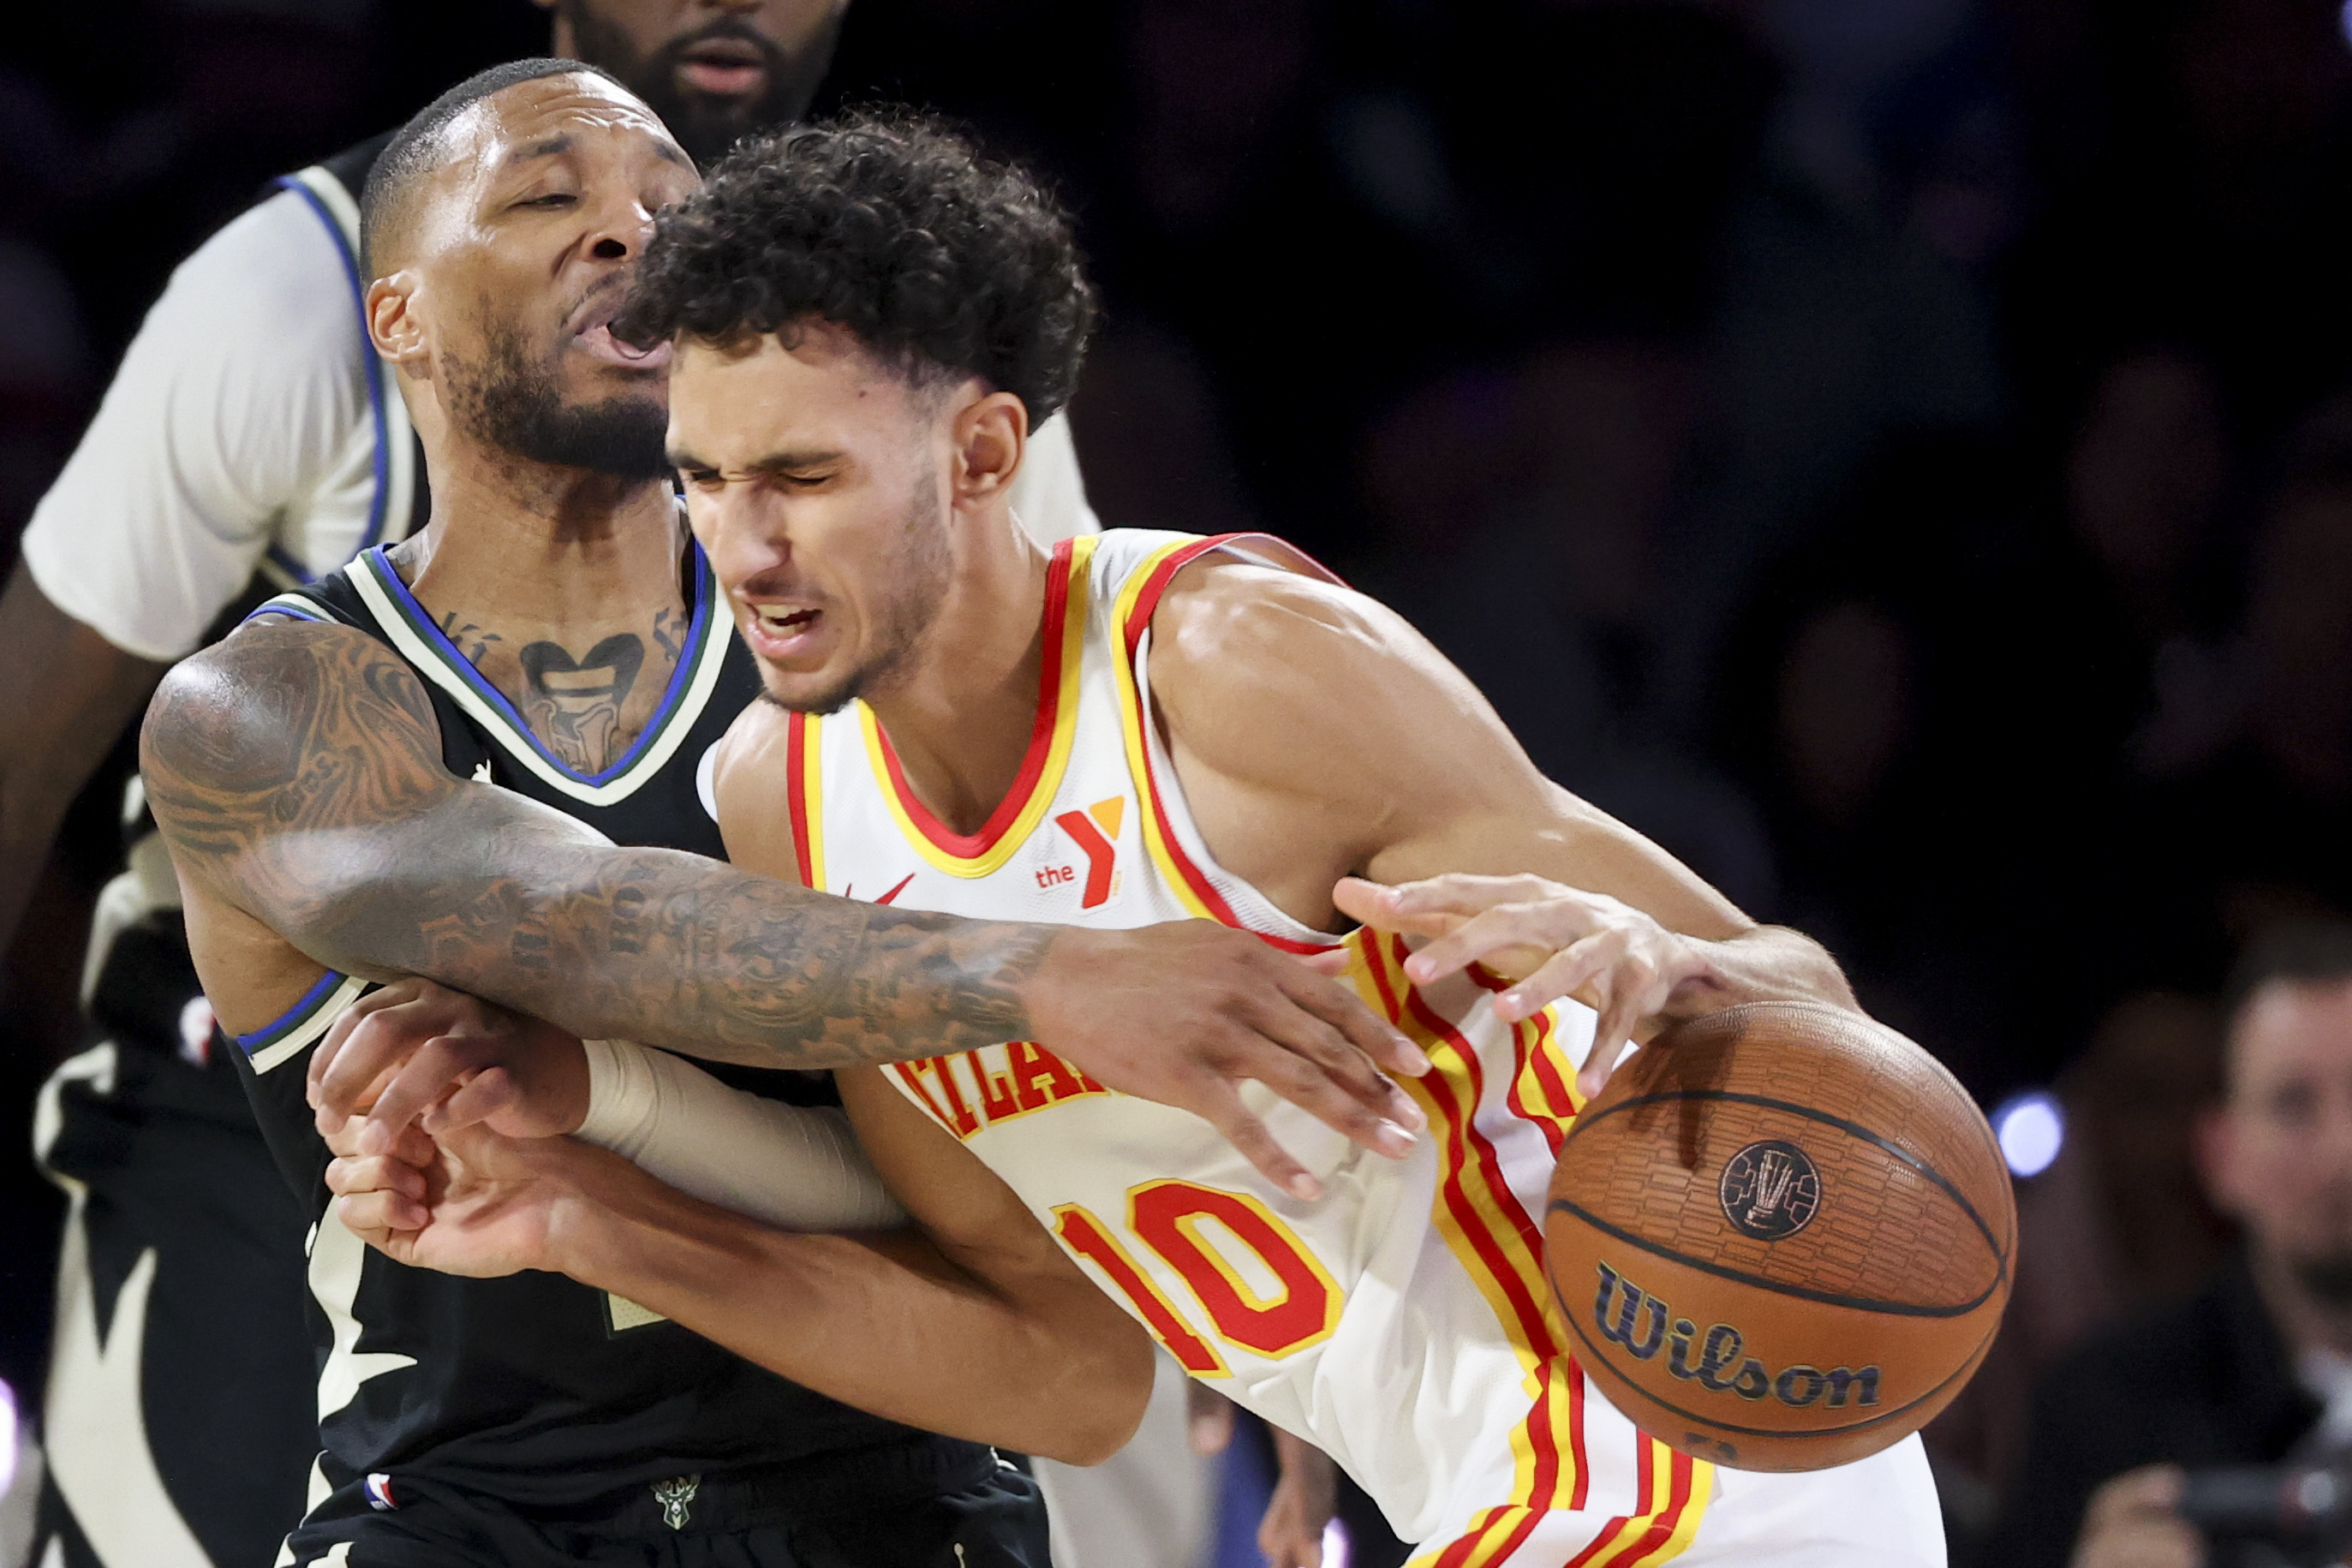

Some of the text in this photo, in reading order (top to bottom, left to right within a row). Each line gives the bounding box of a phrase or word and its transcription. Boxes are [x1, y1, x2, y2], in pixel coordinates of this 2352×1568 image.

[1036, 865, 1075, 888] the
[1049, 1177, 1345, 1379] 10
[1593, 1258, 1881, 1409] Wilson
